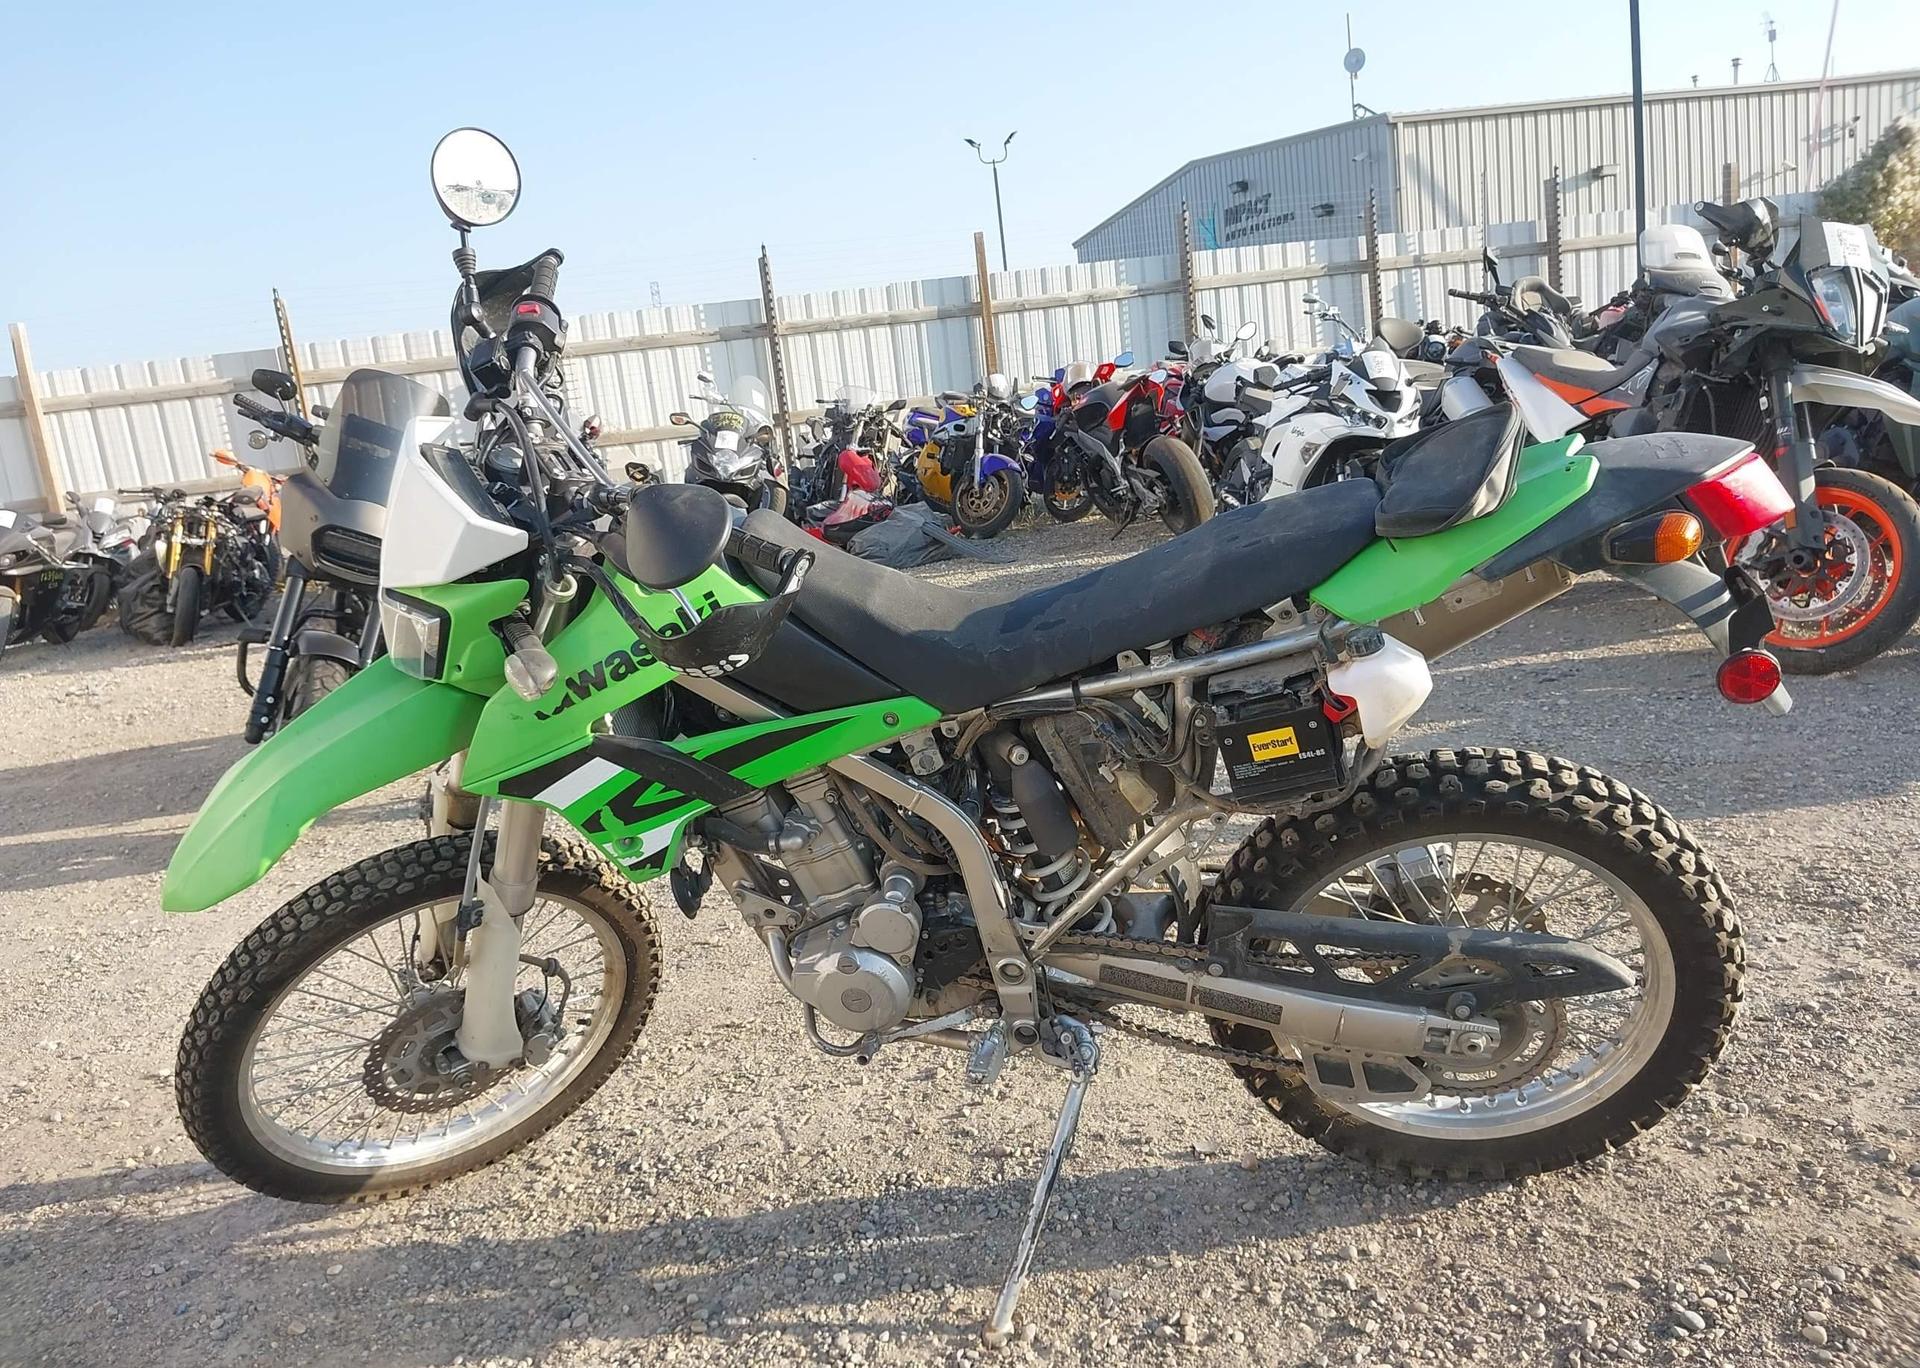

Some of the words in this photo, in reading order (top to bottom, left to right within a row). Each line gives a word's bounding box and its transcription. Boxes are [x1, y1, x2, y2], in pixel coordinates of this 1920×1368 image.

[1224, 193, 1272, 227] IMPACT
[1225, 226, 1247, 242] AUTO
[1249, 211, 1295, 234] AUCTIONS
[534, 591, 722, 721] waski
[1252, 736, 1294, 752] EverStart
